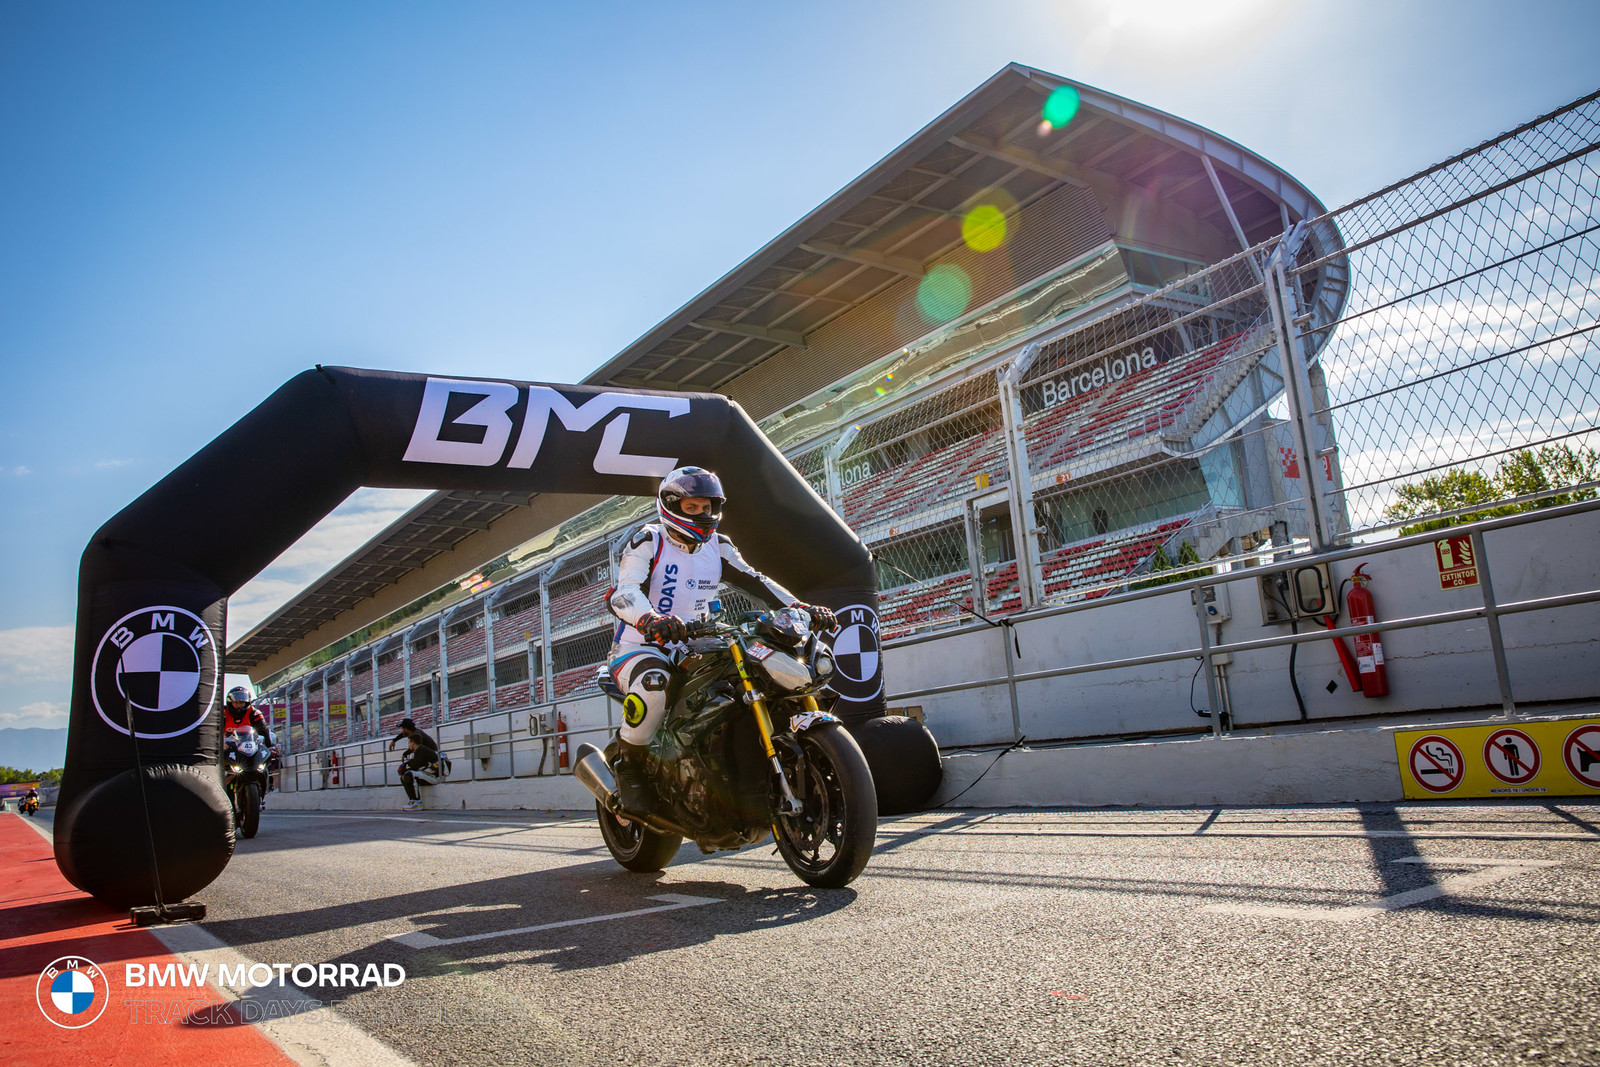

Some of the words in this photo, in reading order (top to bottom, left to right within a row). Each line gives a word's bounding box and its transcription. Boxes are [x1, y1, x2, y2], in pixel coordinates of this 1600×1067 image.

[1042, 346, 1157, 407] Barcelona
[402, 377, 691, 477] BMC
[1442, 570, 1475, 581] EXTINTOR
[110, 612, 210, 650] BMW
